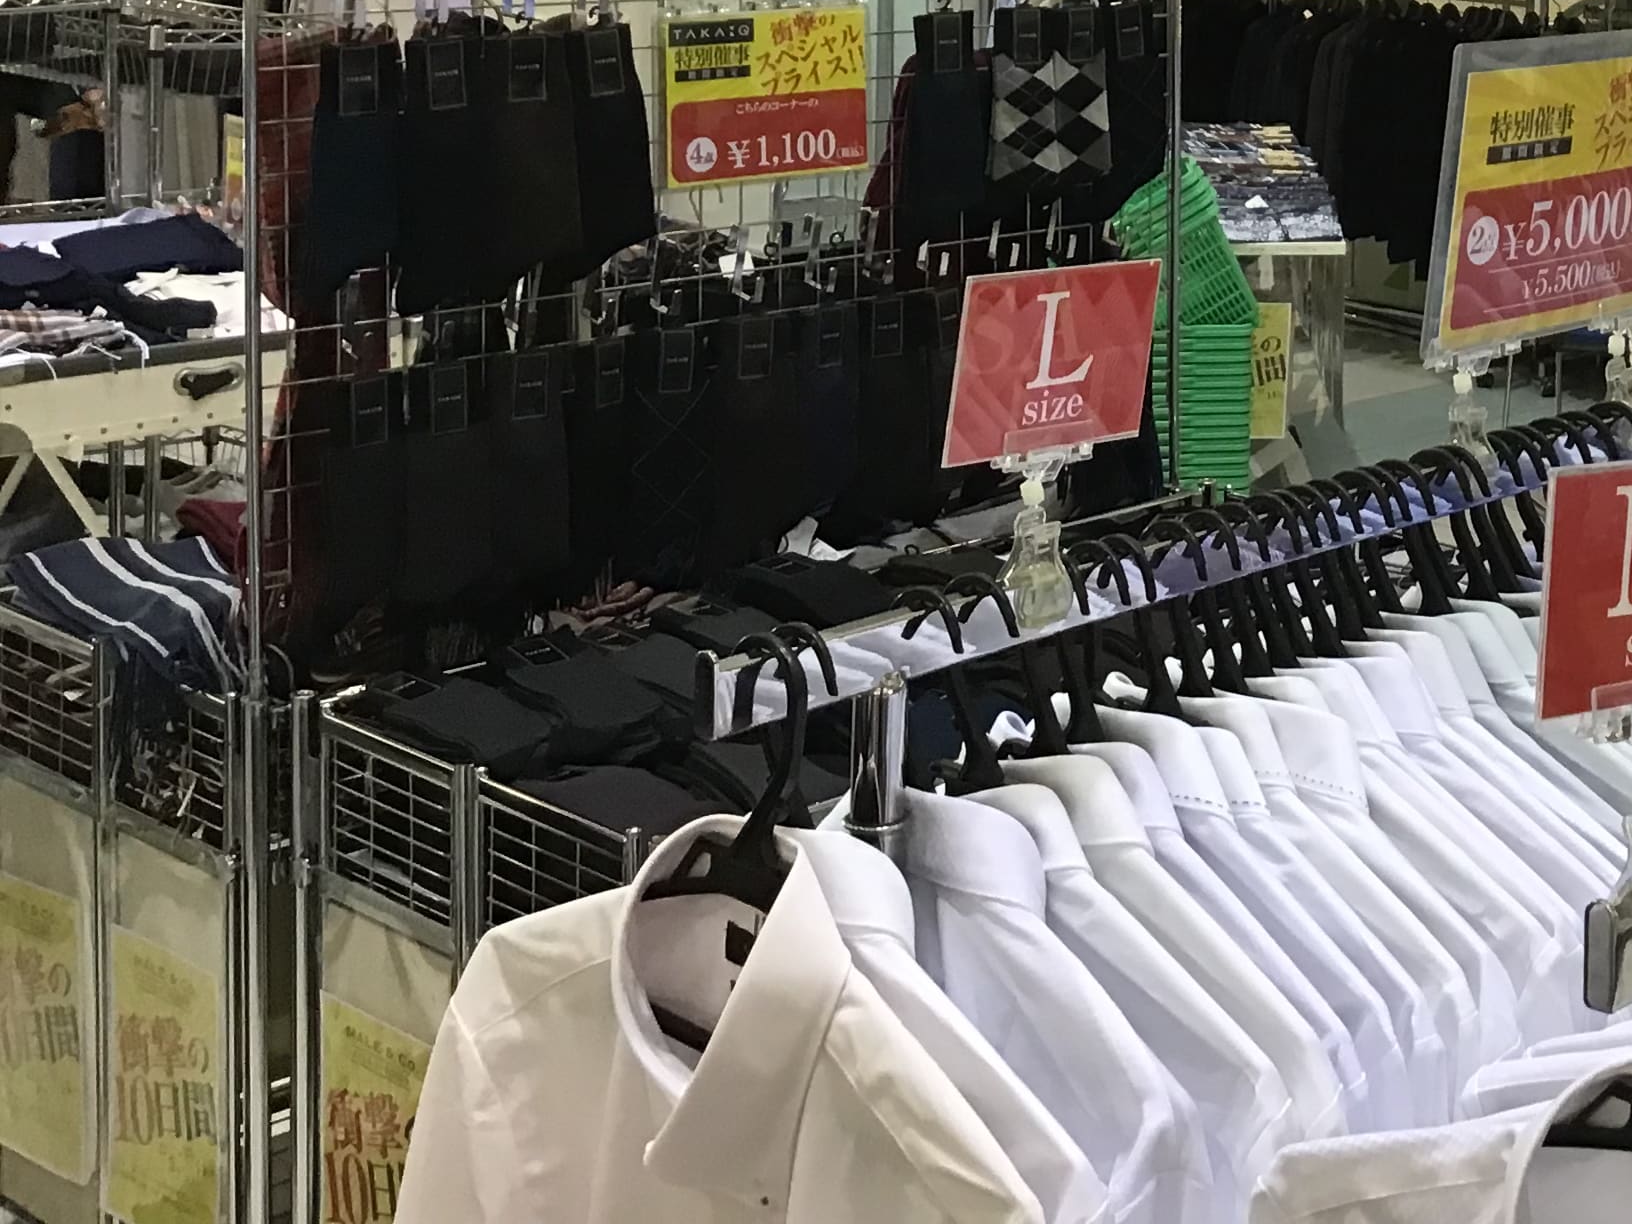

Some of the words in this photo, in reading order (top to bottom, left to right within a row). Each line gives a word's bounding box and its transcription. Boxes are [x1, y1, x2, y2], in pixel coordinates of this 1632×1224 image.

[675, 43, 750, 70] 特別催事
[756, 24, 861, 74] スペシャル
[736, 97, 819, 115] こちらのコーナーの
[1489, 102, 1576, 145] 特別催事
[727, 128, 836, 169] ¥1,100
[1502, 186, 1632, 261] ¥5,000
[1522, 260, 1592, 300] ¥5,500
[1026, 291, 1094, 390] L
[1021, 389, 1083, 426] size
[119, 1012, 209, 1077] 衝撃の
[116, 1076, 217, 1146] 10日間
